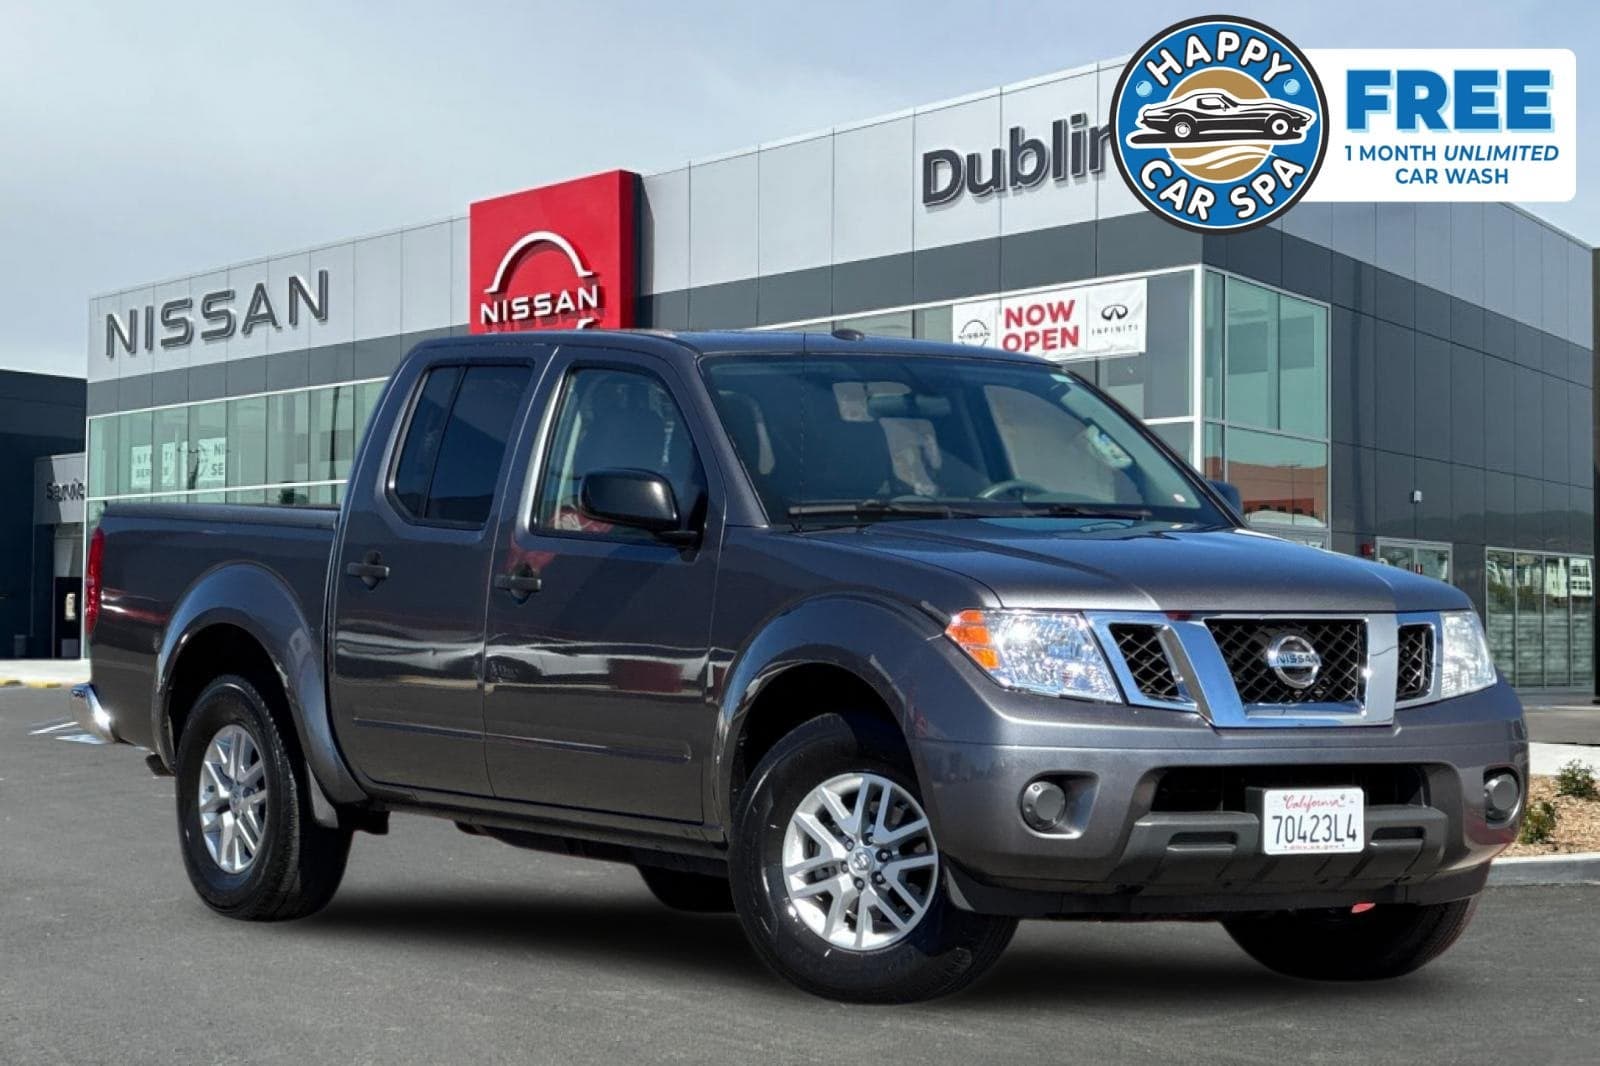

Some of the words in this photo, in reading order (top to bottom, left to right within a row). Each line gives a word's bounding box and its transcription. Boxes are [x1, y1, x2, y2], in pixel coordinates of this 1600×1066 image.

[106, 269, 329, 358] NISSAN
[480, 285, 598, 325] NISSAN
[1005, 299, 1076, 329] NOW
[1002, 325, 1079, 353] OPEN
[1276, 654, 1318, 664] NISSAN
[1285, 795, 1340, 813] California
[1272, 813, 1357, 844] 70423L4
